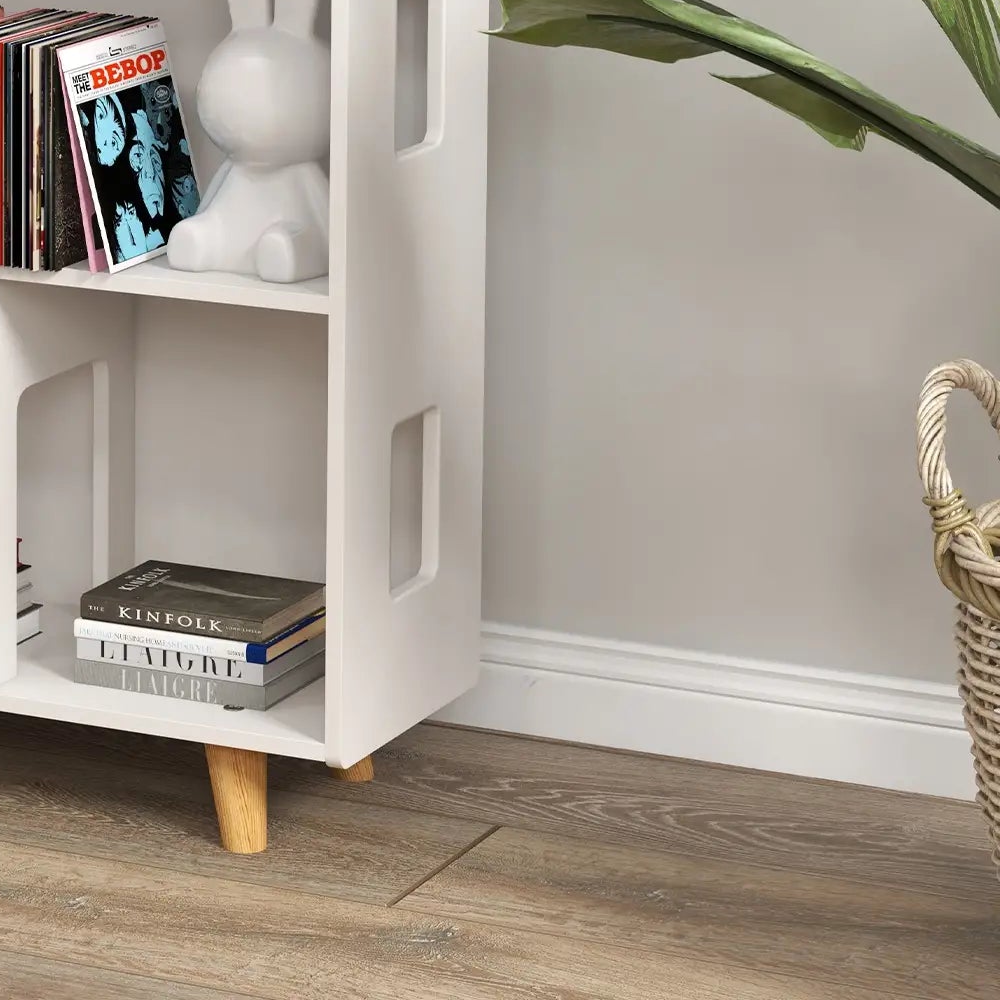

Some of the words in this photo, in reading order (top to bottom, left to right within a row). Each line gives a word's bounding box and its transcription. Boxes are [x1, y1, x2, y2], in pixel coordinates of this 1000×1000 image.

[72, 73, 89, 83] MEET
[90, 49, 165, 90] BEBOP
[74, 81, 91, 94] THE
[118, 568, 170, 591] KINFOLK
[118, 606, 222, 632] KINFOLK
[122, 669, 217, 704] LIAIGRE
